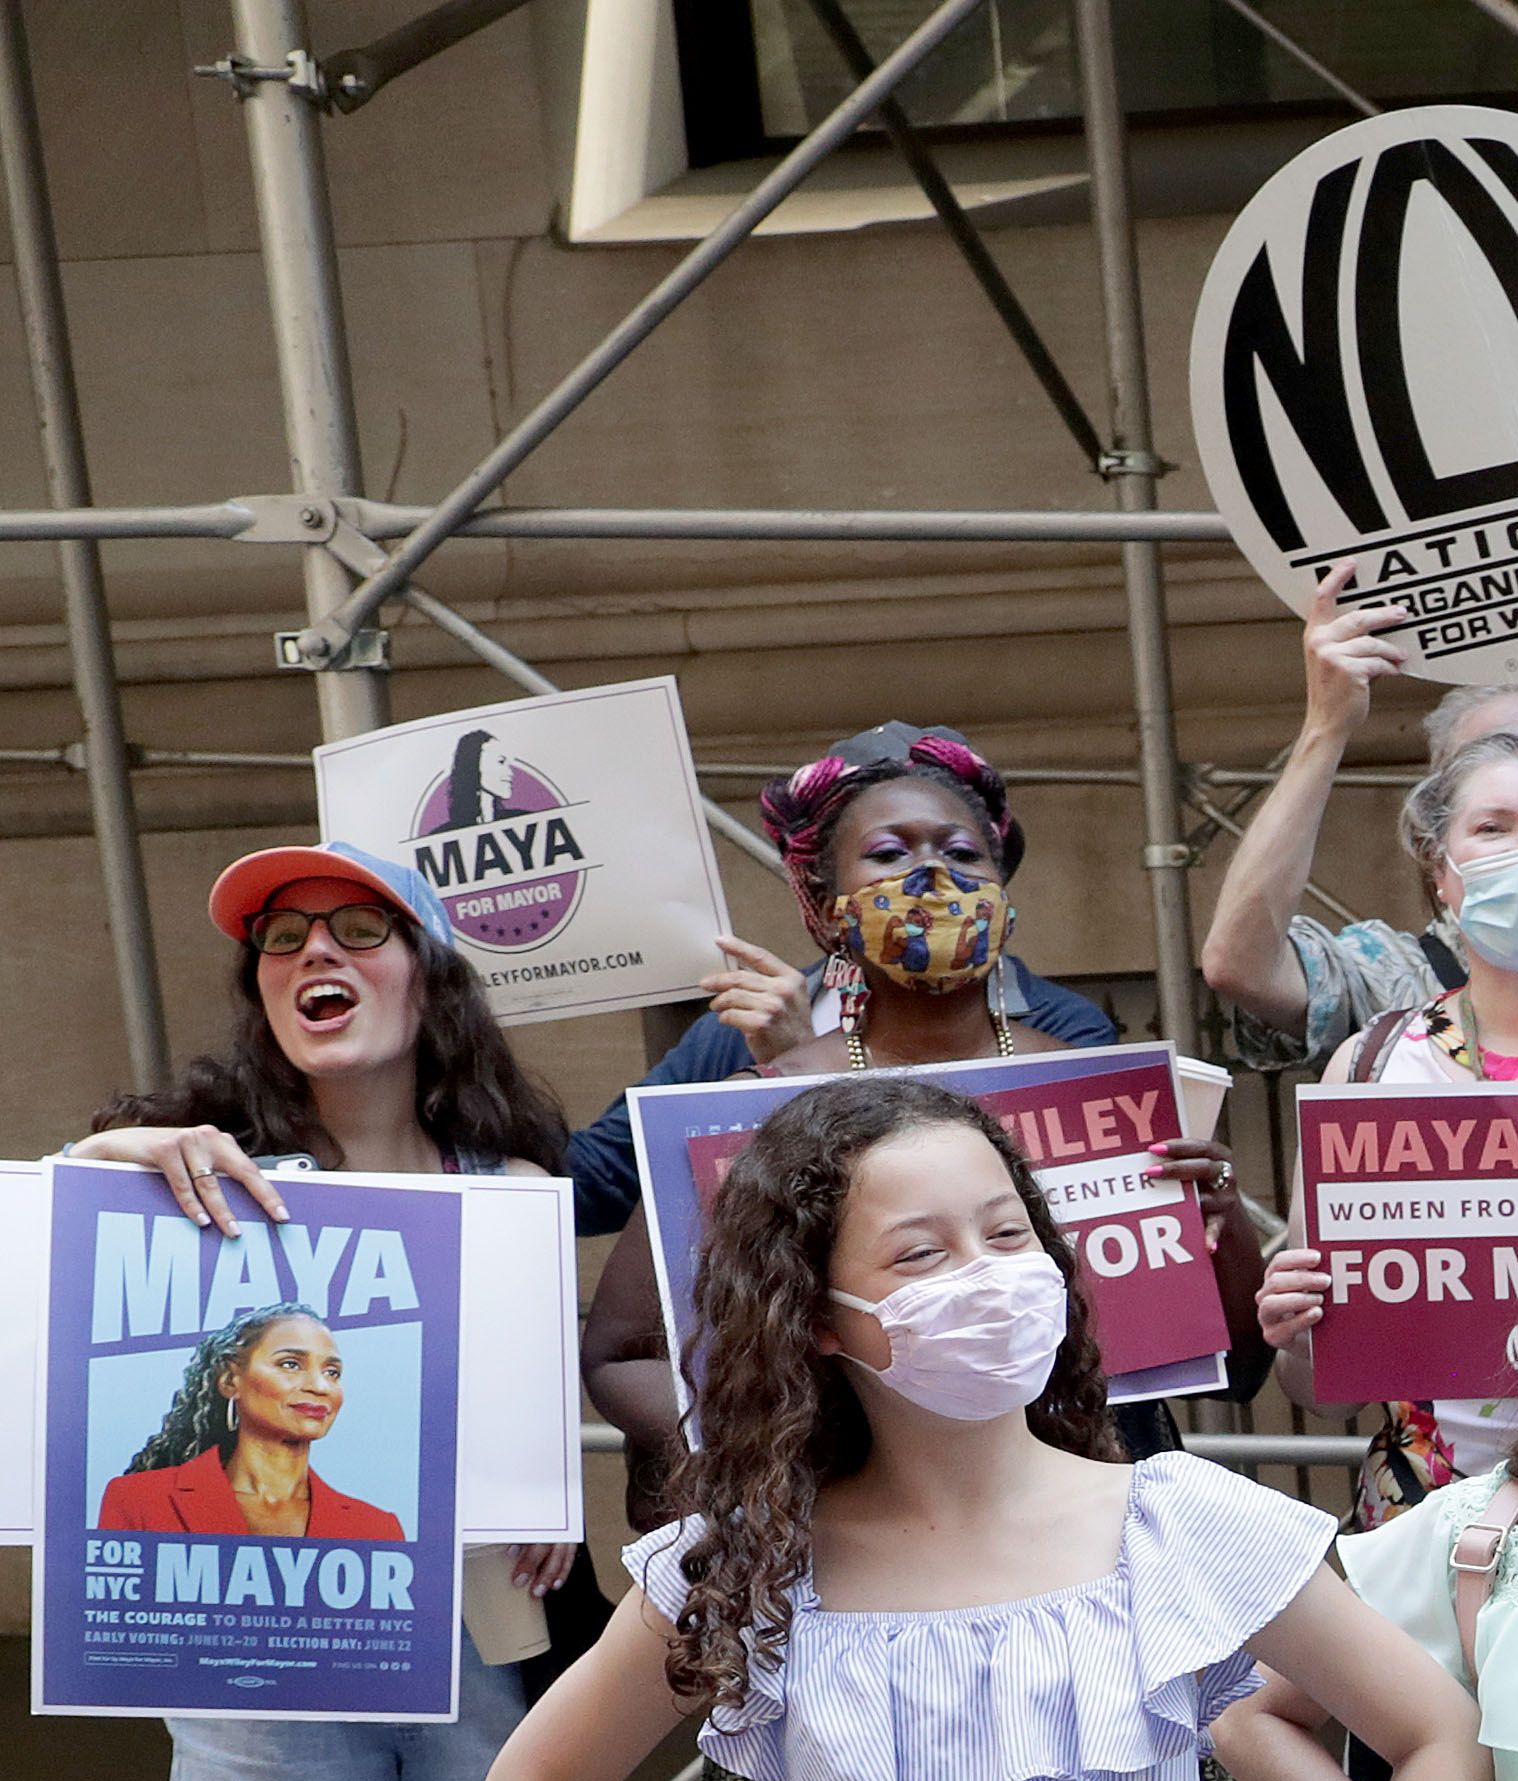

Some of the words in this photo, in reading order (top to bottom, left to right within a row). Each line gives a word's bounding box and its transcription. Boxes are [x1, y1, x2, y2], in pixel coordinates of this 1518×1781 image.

[1417, 616, 1492, 650] FOR
[415, 817, 585, 888] MAYA
[455, 897, 496, 920] FOR
[495, 883, 562, 912] MAYOR
[483, 951, 643, 989] LEYFORMAYOR.COM
[1001, 1090, 1159, 1161] ILEY
[1046, 1172, 1155, 1205] CENTER
[1329, 1201, 1446, 1221] WOMEN
[91, 1211, 419, 1343] MAYA
[1330, 1247, 1473, 1304] FOR
[86, 1541, 142, 1566] FOR
[86, 1576, 141, 1600] NYC
[155, 1543, 415, 1610] MAYOR
[85, 1610, 120, 1624] THE
[124, 1611, 207, 1626] COURAGE
[213, 1614, 236, 1626] TO
[241, 1615, 292, 1628] BUILD
[296, 1617, 308, 1628] A
[312, 1617, 375, 1631] BETTER
[380, 1619, 413, 1632] NYC
[85, 1631, 126, 1644] EARLY
[129, 1632, 183, 1645] VOTING:
[268, 1636, 329, 1649] ELECTION
[332, 1637, 362, 1650] DAY:
[398, 1640, 411, 1651] 22
